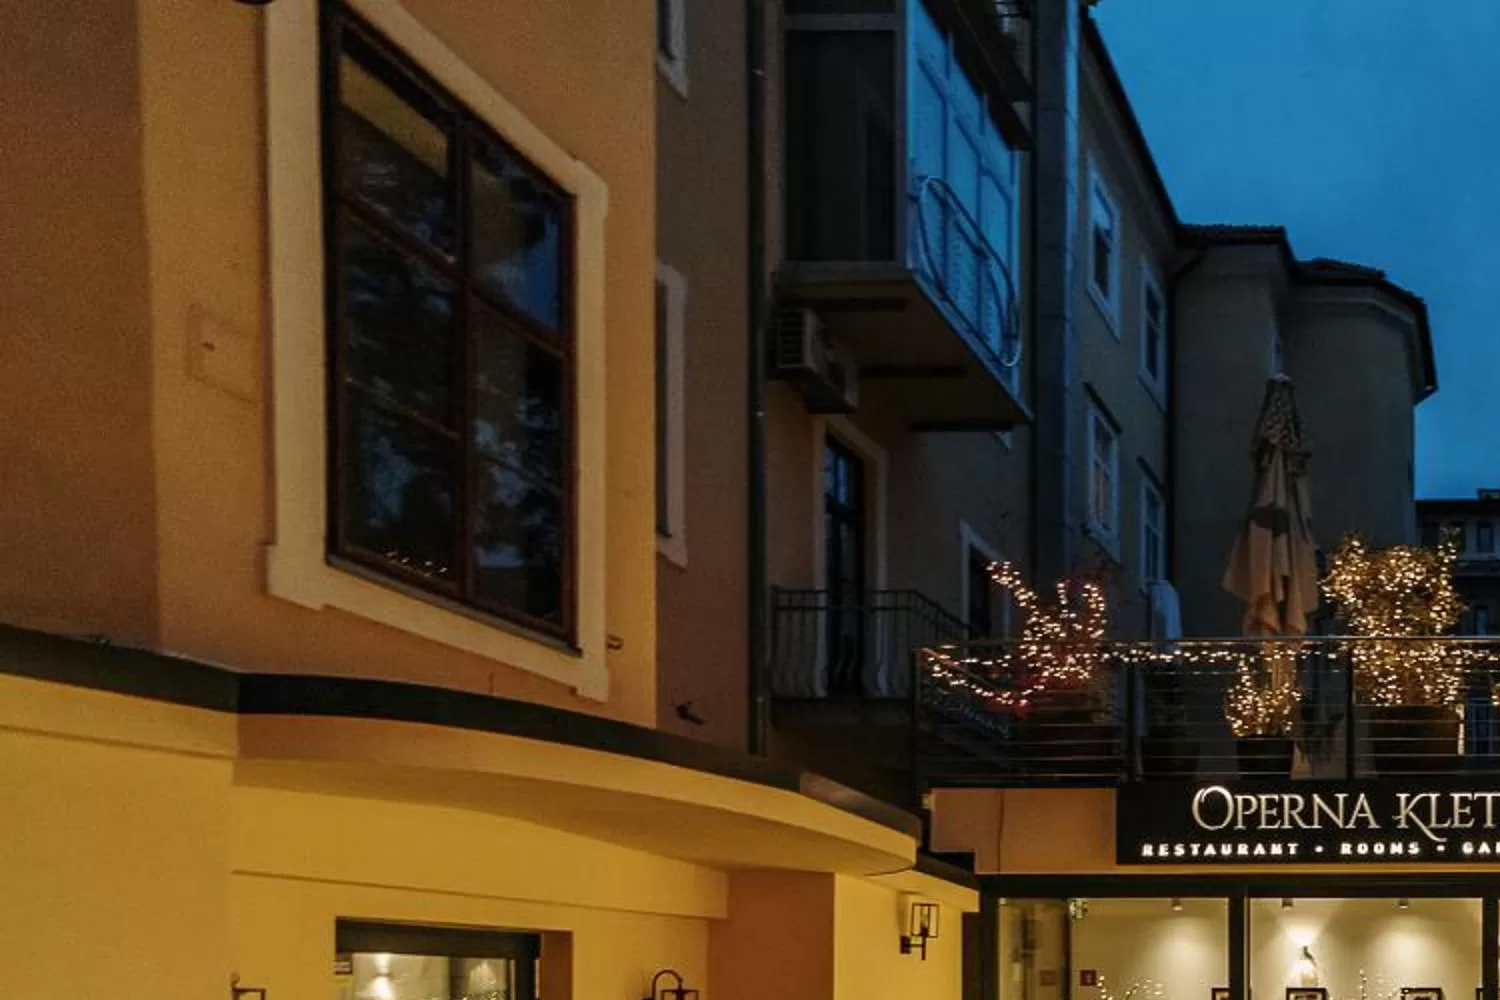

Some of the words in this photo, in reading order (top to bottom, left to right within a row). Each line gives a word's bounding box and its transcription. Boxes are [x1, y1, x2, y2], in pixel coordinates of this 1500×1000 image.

[1191, 784, 1381, 831] OPERNA
[1141, 842, 1300, 858] RESTAURANT
[1339, 841, 1421, 856] ROOMS
